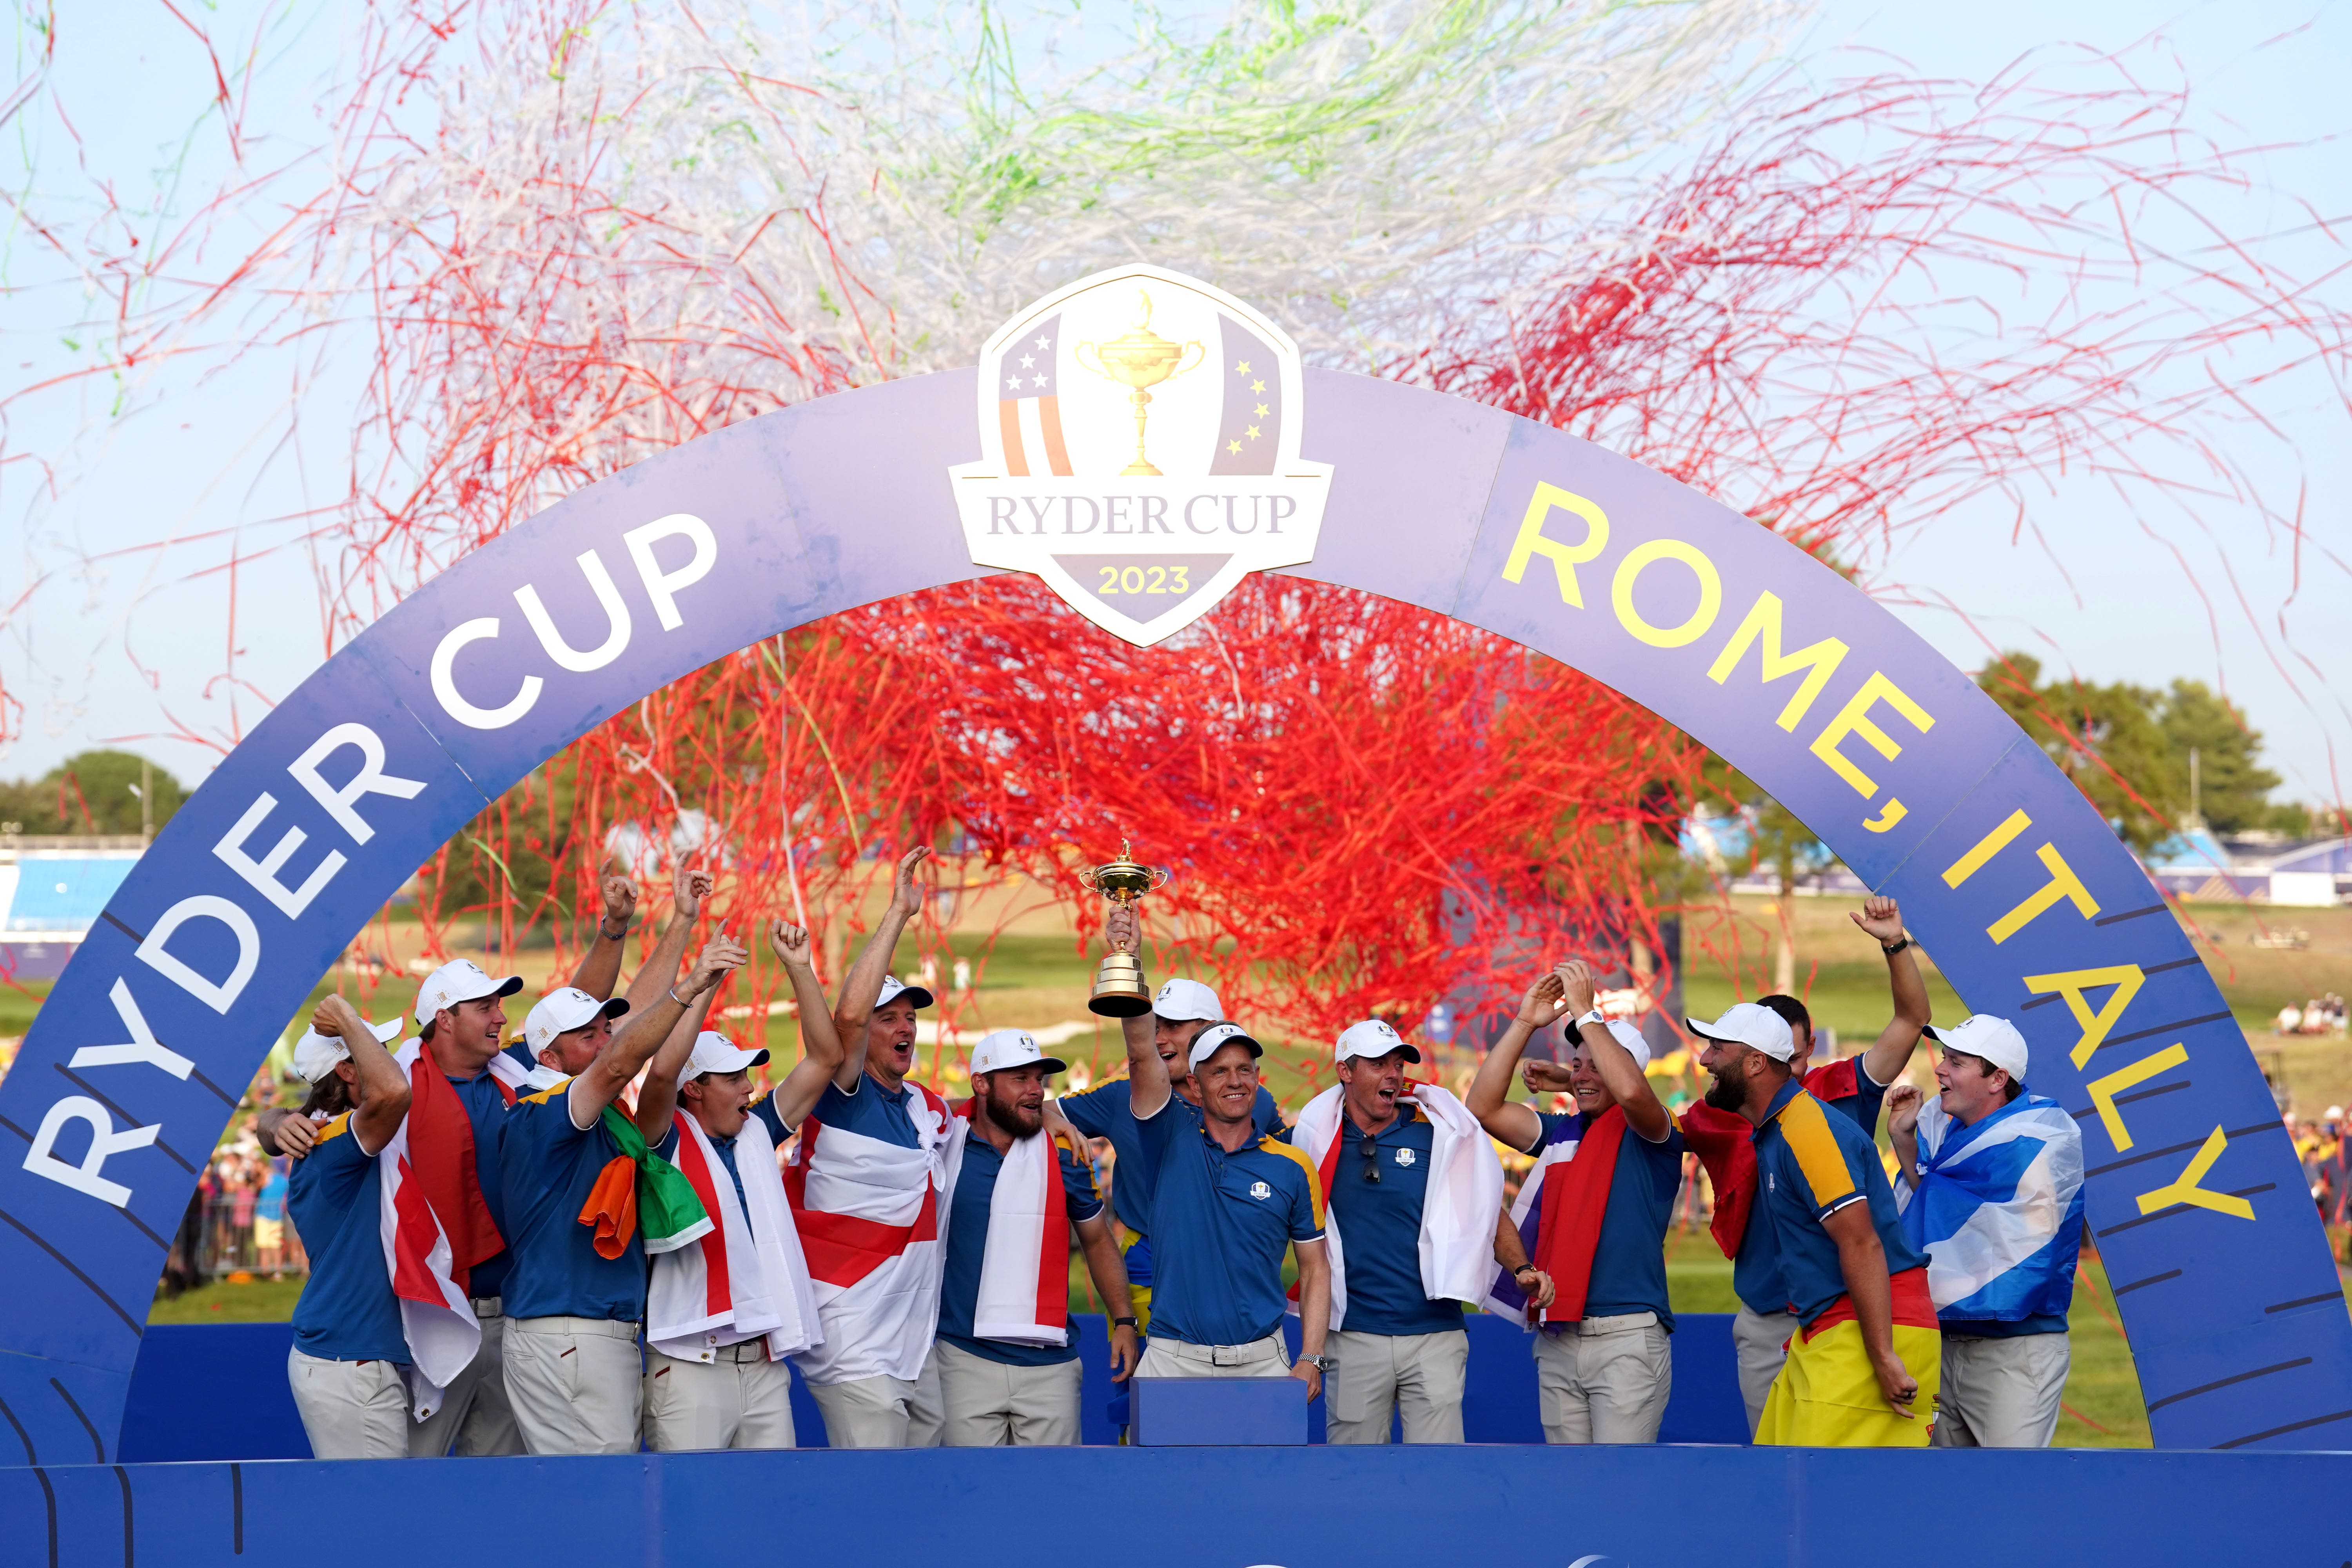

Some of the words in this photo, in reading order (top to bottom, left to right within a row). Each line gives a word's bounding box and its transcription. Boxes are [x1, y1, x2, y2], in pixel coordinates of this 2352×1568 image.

[986, 496, 1175, 535] RYDER
[1184, 494, 1296, 535] CUP
[1099, 566, 1189, 593] 2023
[22, 723, 427, 1208] RYDER
[431, 513, 717, 729] CUP
[1502, 481, 1935, 833] ROME,
[1942, 808, 2255, 1220] ITALY
[437, 991, 448, 1003] EUR
[333, 1041, 345, 1052] EUR
